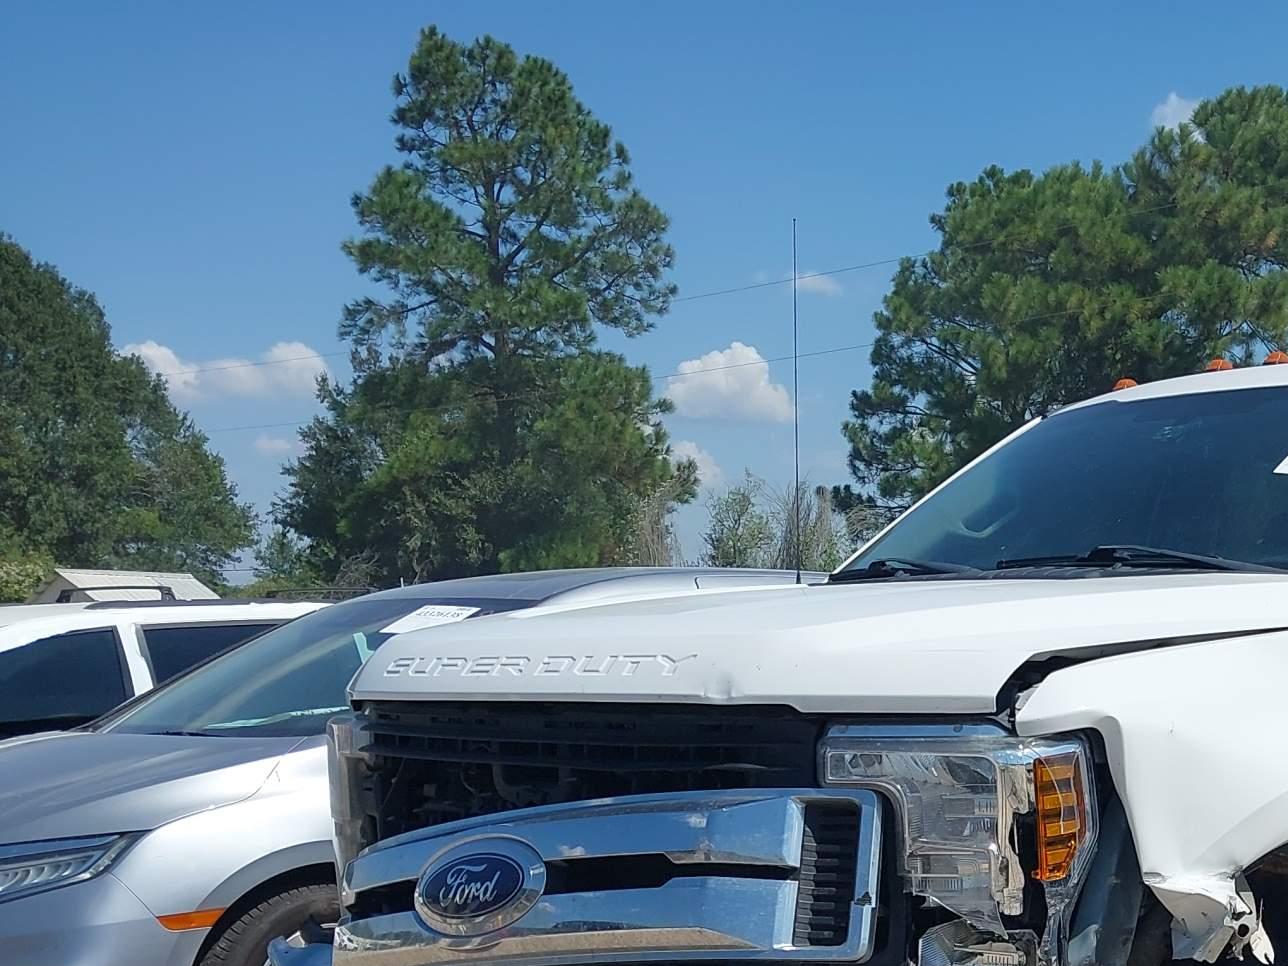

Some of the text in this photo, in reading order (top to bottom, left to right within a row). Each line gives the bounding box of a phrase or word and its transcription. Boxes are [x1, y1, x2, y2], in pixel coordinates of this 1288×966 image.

[384, 654, 697, 677] SUPER DUTY
[440, 864, 497, 906] Ford
